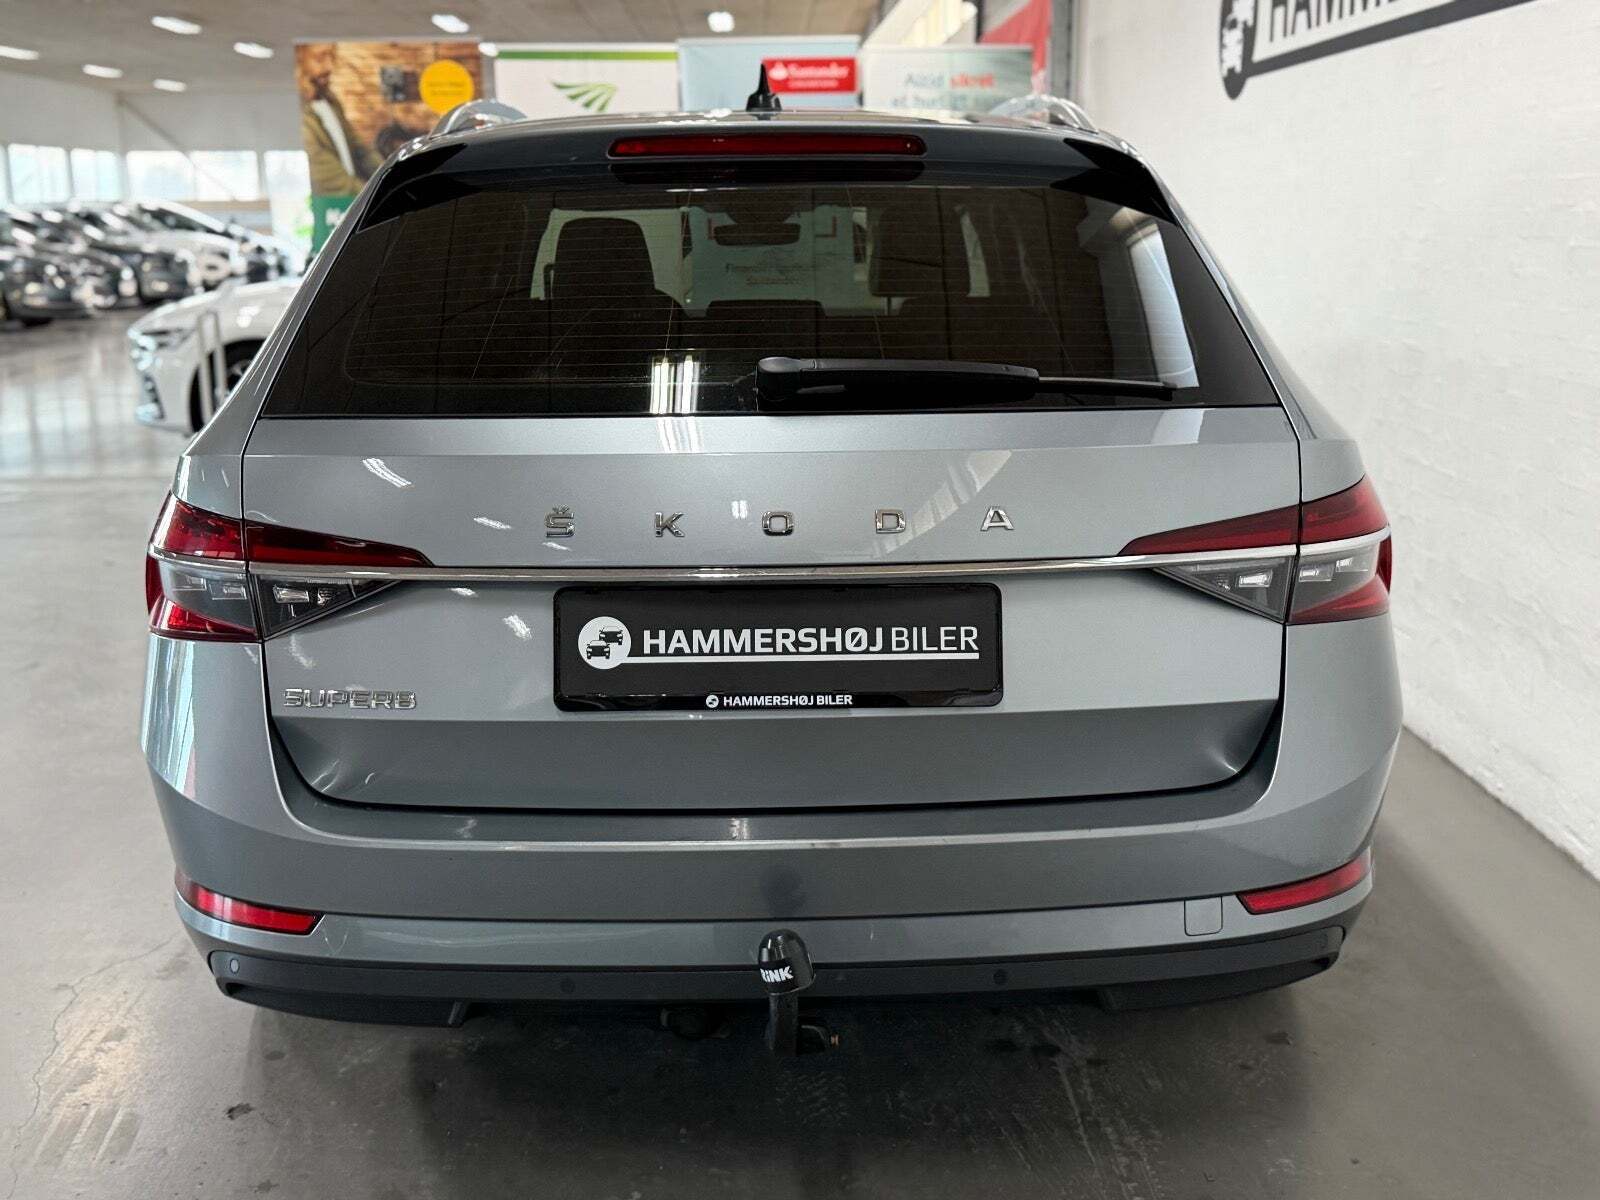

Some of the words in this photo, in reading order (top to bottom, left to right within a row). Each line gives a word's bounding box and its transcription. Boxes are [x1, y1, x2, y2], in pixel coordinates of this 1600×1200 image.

[544, 504, 1015, 538] ŠKODA
[642, 626, 883, 655] HAMMERSHØJ
[891, 626, 979, 651] BILER
[283, 687, 417, 710] SUPERB
[723, 695, 814, 707] HAMMERSHØJ
[816, 694, 854, 705] BILER
